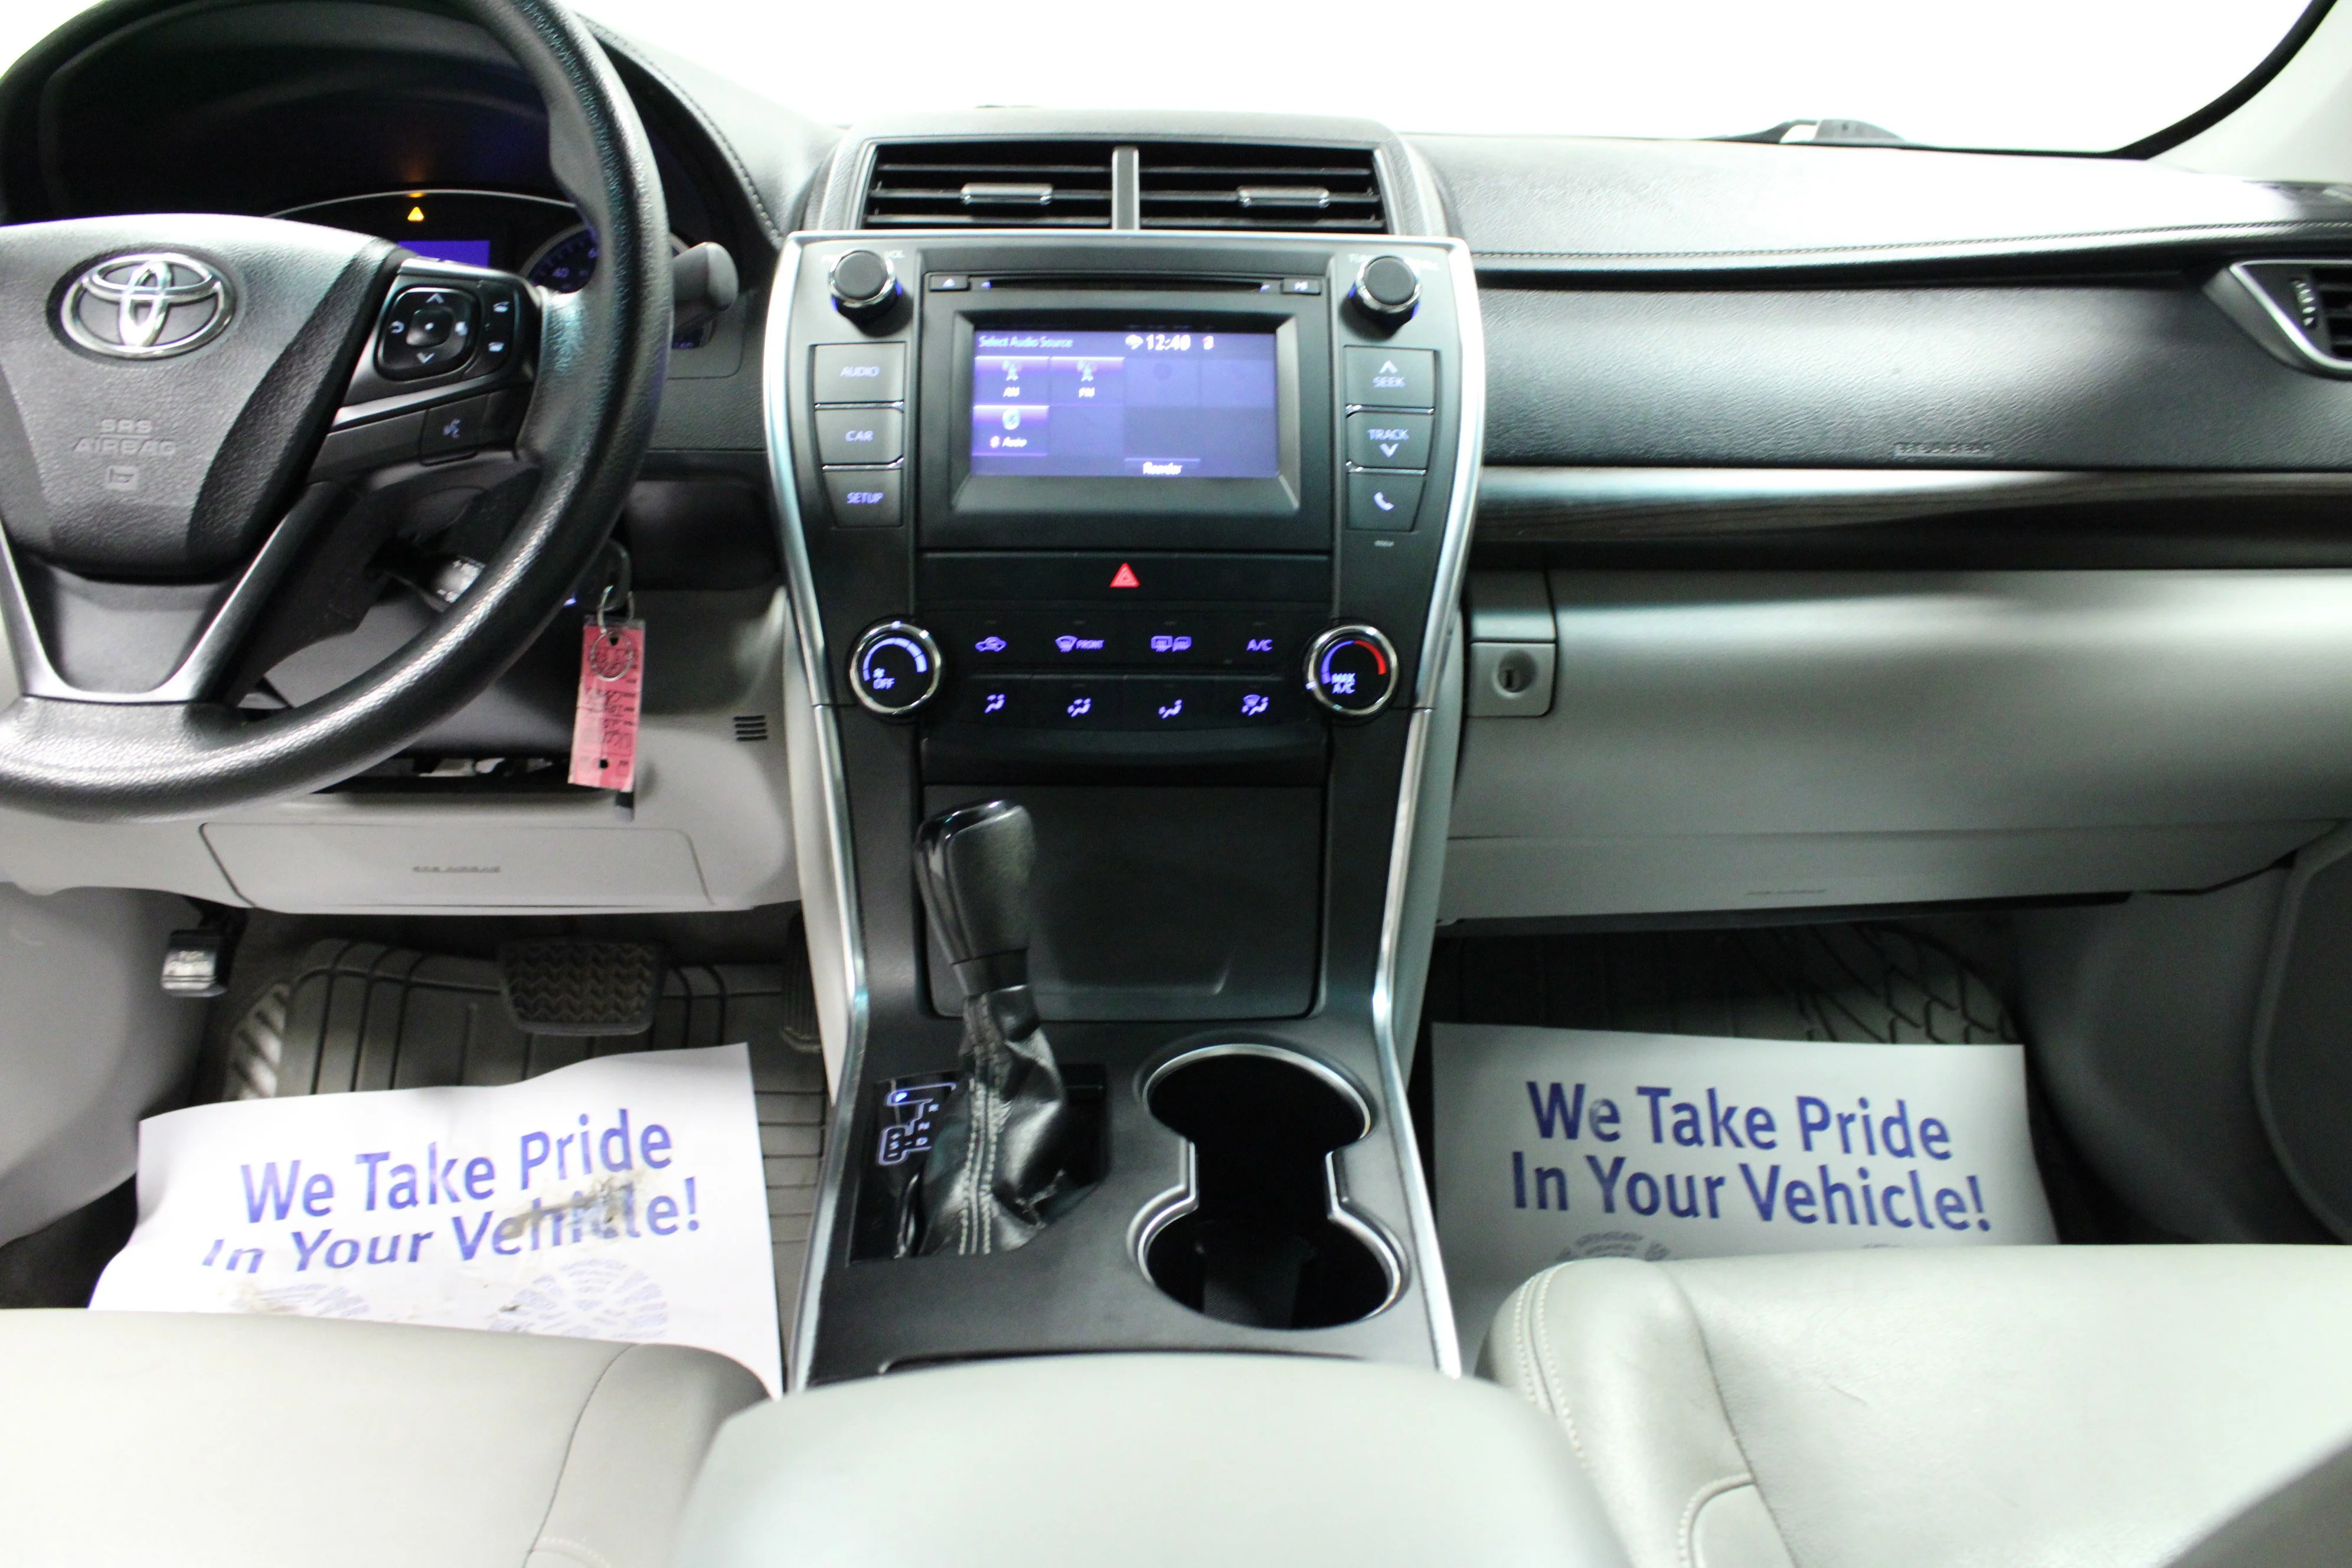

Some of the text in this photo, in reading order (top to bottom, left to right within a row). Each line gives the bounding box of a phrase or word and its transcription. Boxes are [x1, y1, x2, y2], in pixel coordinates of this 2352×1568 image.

[978, 335, 1073, 347] Select Audio Source
[1146, 334, 1191, 351] 12:40
[840, 366, 880, 377] AUDIO
[1373, 376, 1406, 388] SEEK
[845, 430, 874, 442] CAR
[1367, 429, 1409, 440] TRACK
[72, 437, 177, 456] AIRBAG
[847, 492, 884, 504] SETUP
[1076, 639, 1105, 649] FRONT
[1246, 639, 1274, 651] A/C
[873, 678, 896, 690] OFF
[1331, 673, 1356, 684] MAX
[1332, 682, 1357, 694] A/C
[1526, 1081, 1952, 1161] We Take Pride
[240, 1108, 673, 1224] We Take Pride
[1512, 1151, 1991, 1232] In Your Vehicle!
[202, 1177, 701, 1273] In Your Vehicle!
